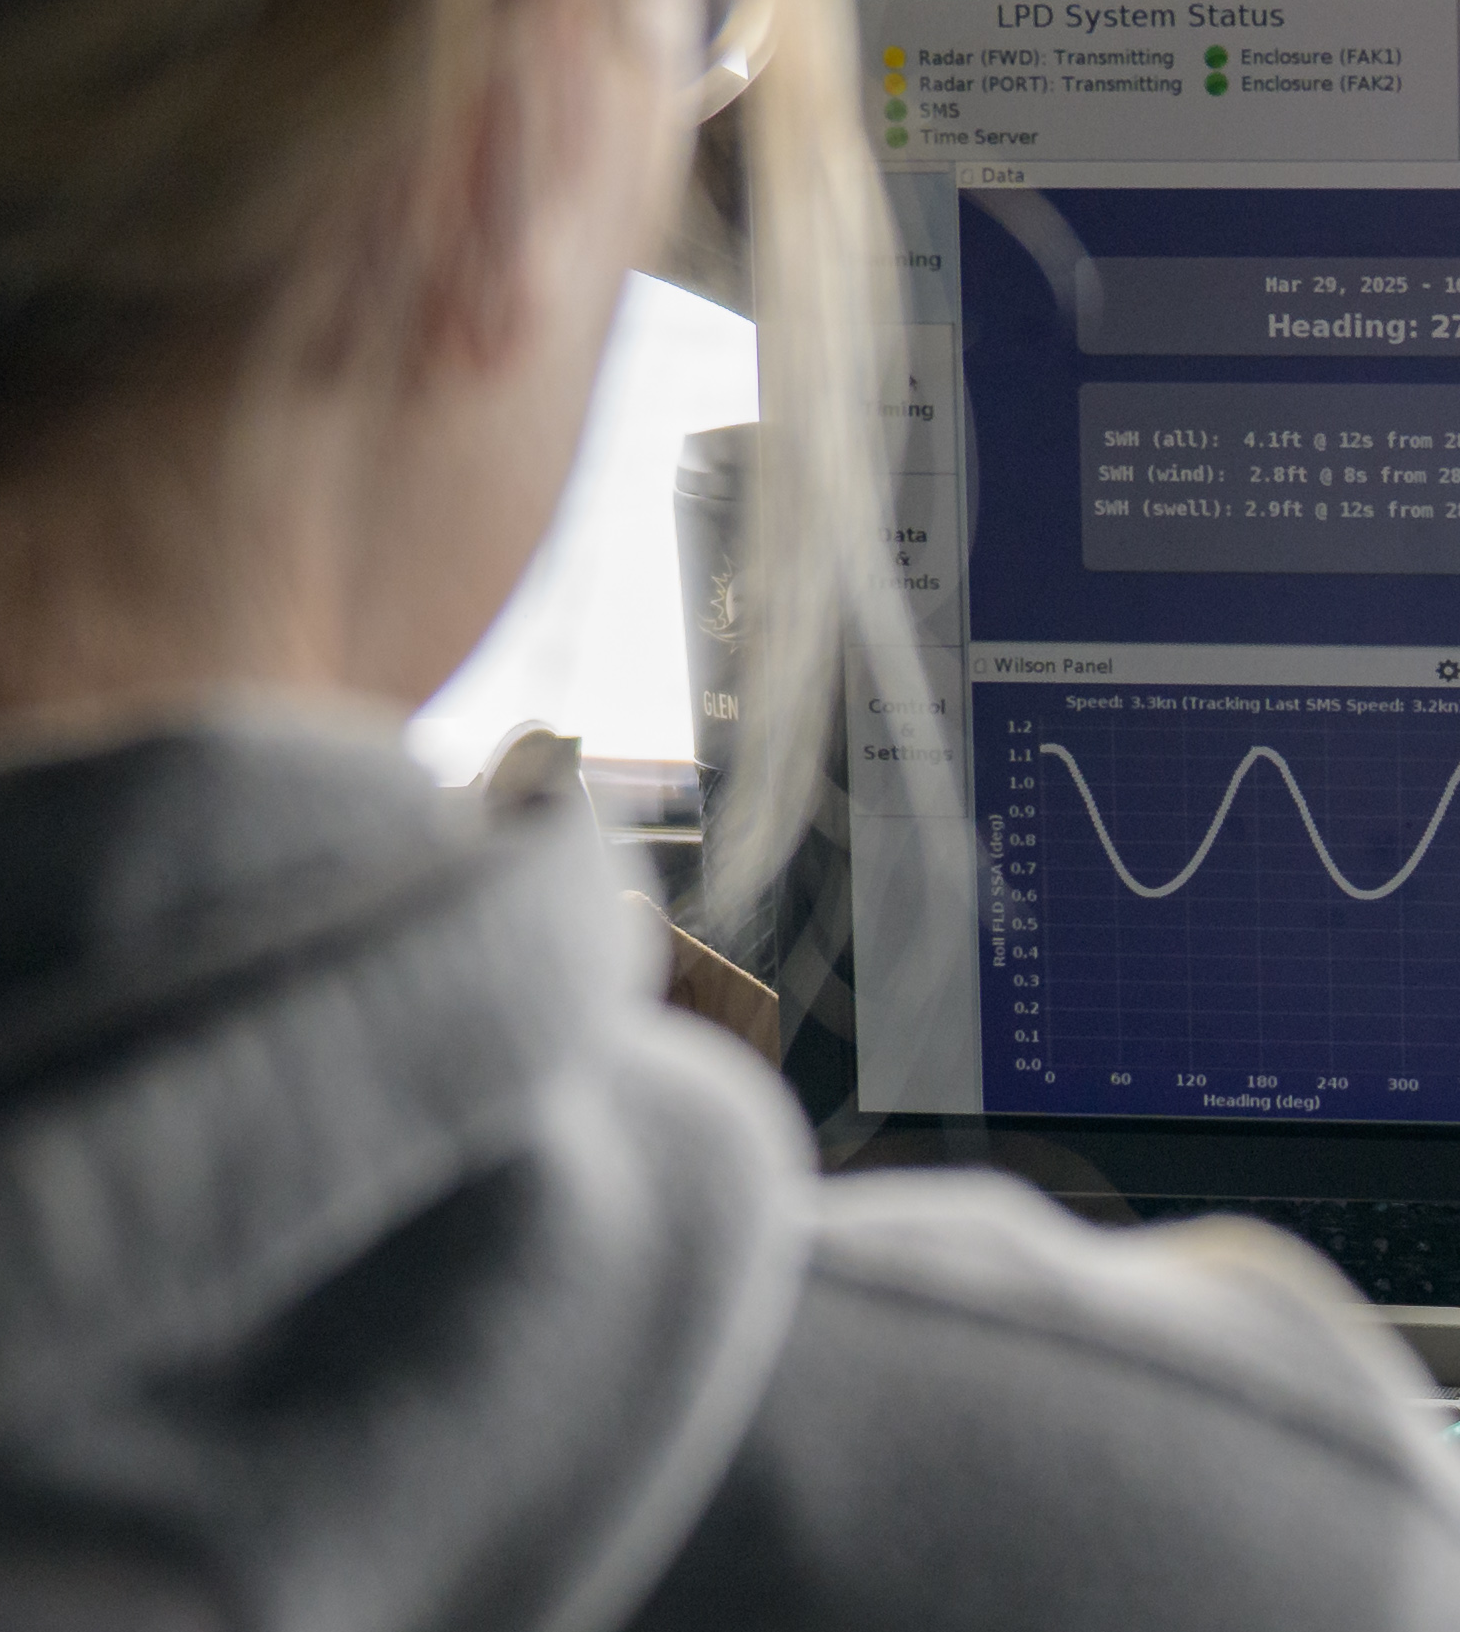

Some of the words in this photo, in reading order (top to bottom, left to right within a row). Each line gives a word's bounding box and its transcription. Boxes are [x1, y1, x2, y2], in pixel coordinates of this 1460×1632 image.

[998, 4, 1054, 29] LPD
[1066, 3, 1176, 33] System
[1188, 3, 1284, 27] Status
[920, 49, 974, 66] Radar
[981, 49, 1046, 67] (FWD):
[1055, 49, 1174, 69] Transmitting
[1242, 49, 1333, 65] Enclosure
[1340, 48, 1402, 67] (FAK1)
[920, 76, 974, 93] Radar
[982, 75, 1054, 94] (PORT):
[1063, 75, 1182, 95] Transmitting
[1242, 75, 1333, 93] Enclosure
[1340, 75, 1402, 95] (FAK2)
[920, 103, 960, 119] SMS
[920, 129, 969, 145] Time
[975, 129, 1038, 145] Server
[982, 168, 1025, 183] Data
[1265, 277, 1302, 294] Mar
[1313, 277, 1345, 297] 29,
[1360, 277, 1408, 294] 2025
[1267, 313, 1419, 344] Heading:
[1104, 431, 1140, 447] SWH
[1152, 430, 1219, 450] (all):
[1243, 431, 1303, 448] 4.1ft
[1313, 433, 1328, 451] @
[1339, 432, 1374, 449] 12s
[1386, 432, 1433, 449] from
[1098, 465, 1134, 482] SWH
[1146, 464, 1226, 485] (wind):
[1249, 466, 1308, 484] 2.8ft
[1319, 467, 1333, 485] @
[1344, 466, 1368, 484] 8s
[1380, 467, 1427, 484] from
[1094, 500, 1129, 517] SWH
[1142, 498, 1233, 520] (swell):
[1245, 501, 1303, 518] 2.9ft
[1314, 502, 1329, 520] @
[1339, 502, 1375, 519] 12s
[1388, 502, 1434, 519] from
[995, 657, 1056, 673] Wilson
[1063, 658, 1113, 674] Panel
[1066, 695, 1123, 712] Speed:
[1130, 696, 1178, 710] 3.3kn
[1182, 695, 1260, 714] (Tracking
[1265, 698, 1300, 711] Last
[1306, 699, 1340, 712] SMS
[1346, 699, 1404, 715] Speed:
[1203, 1094, 1270, 1110] Heading
[1275, 1094, 1320, 1111] (deg)
